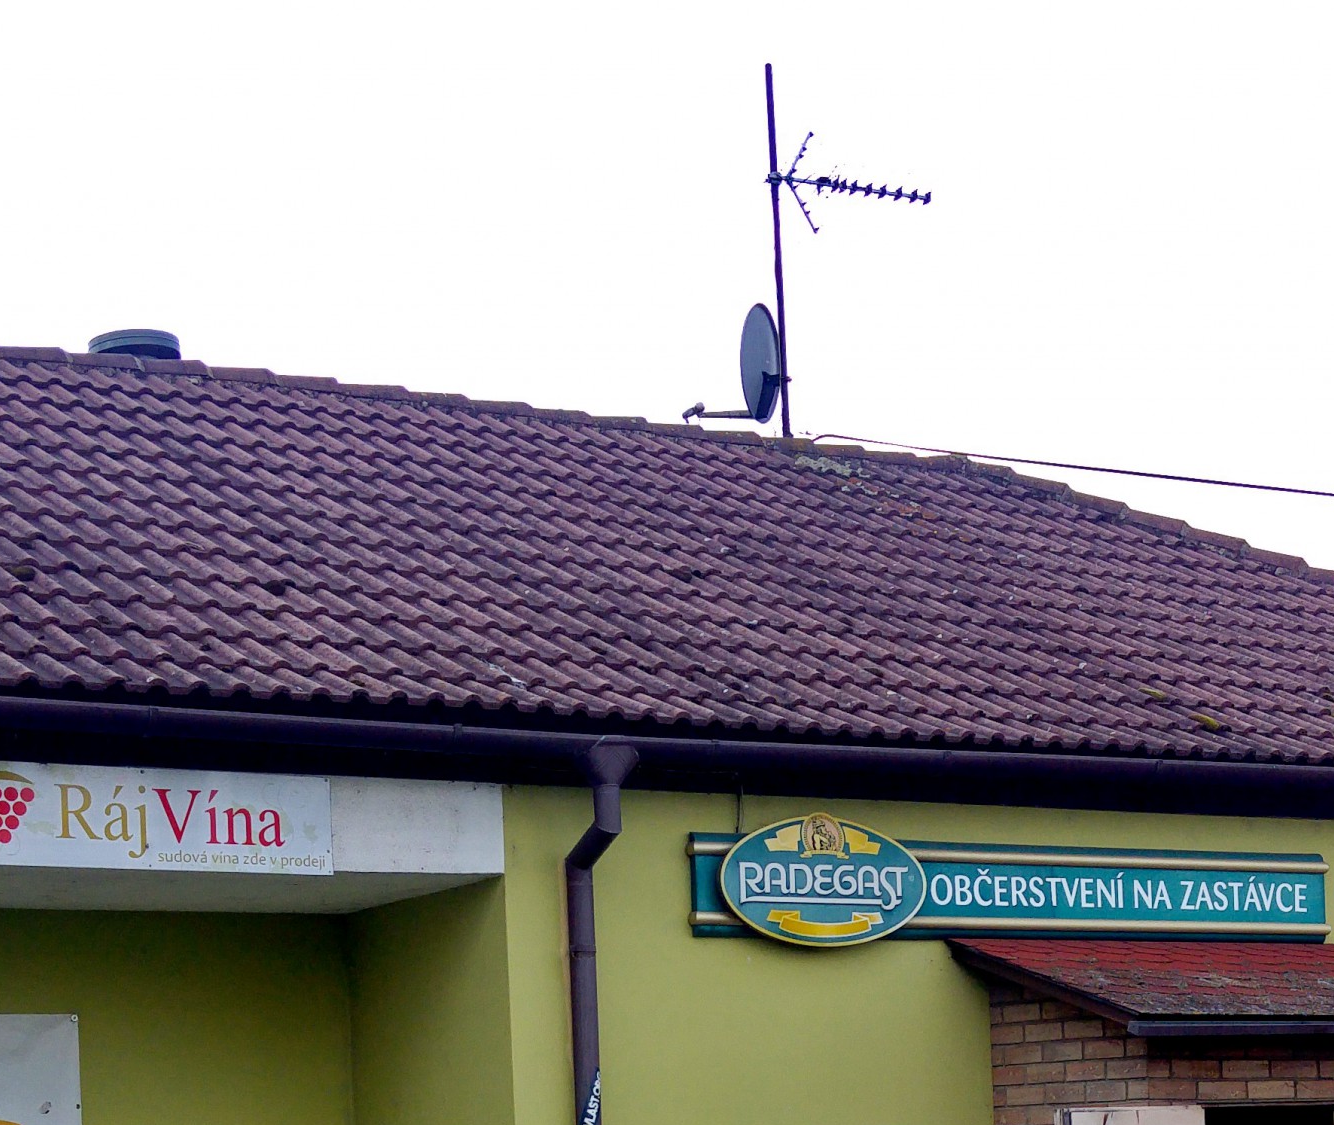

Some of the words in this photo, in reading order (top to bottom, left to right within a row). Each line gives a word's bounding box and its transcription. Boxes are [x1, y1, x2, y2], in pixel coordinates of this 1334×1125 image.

[158, 850, 208, 864] sudová
[243, 852, 267, 866] zde
[270, 855, 278, 866] v
[281, 853, 326, 871] prodeji
[739, 861, 909, 910] RADEGAST
[930, 868, 1124, 911] OBČERSTVENÍ
[1133, 880, 1171, 910] NA
[1180, 876, 1308, 914] ZASTÁVCE
